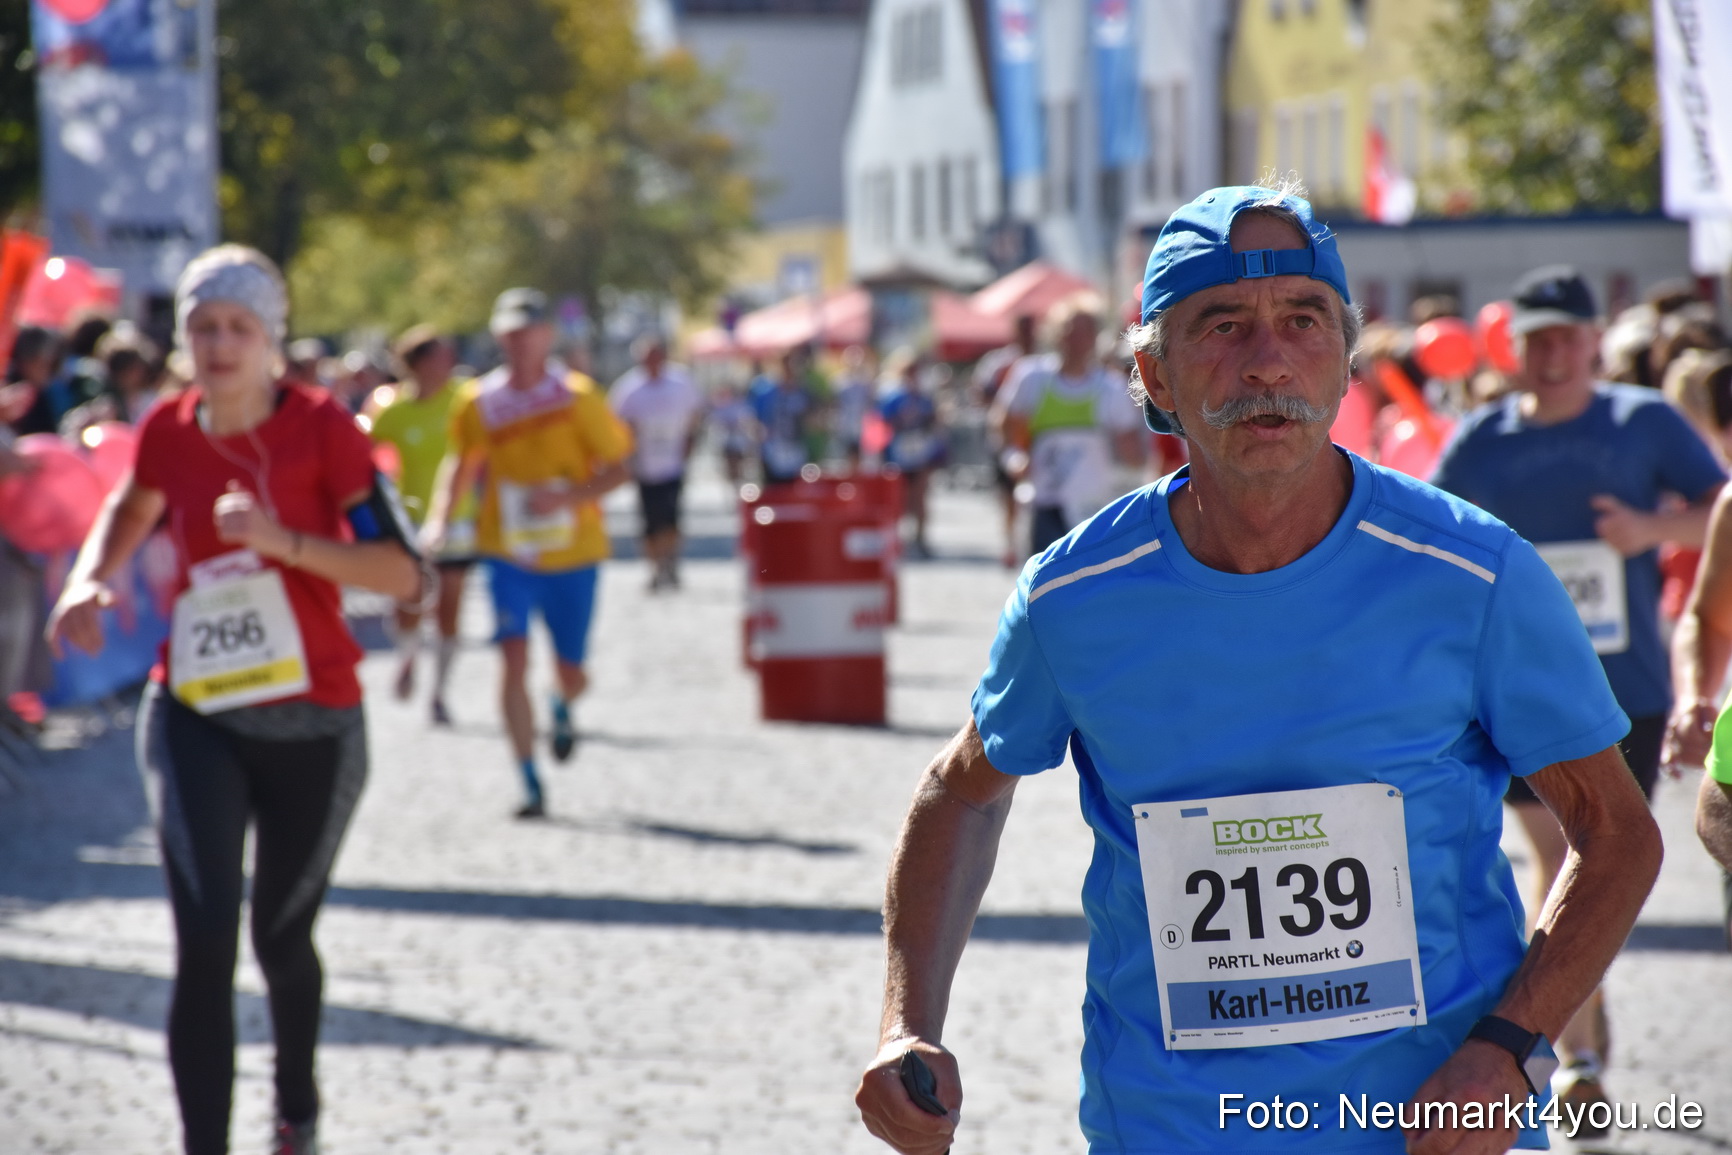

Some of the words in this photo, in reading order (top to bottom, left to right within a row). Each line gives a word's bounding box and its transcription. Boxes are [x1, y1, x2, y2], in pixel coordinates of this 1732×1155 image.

[191, 610, 266, 657] 266
[1213, 813, 1327, 846] BOCK
[1215, 846, 1248, 856] inspired
[1250, 845, 1261, 855] by
[1262, 843, 1288, 853] smart
[1289, 840, 1329, 850] concepts
[1185, 857, 1371, 943] 2139
[1167, 930, 1176, 943] D
[1208, 954, 1260, 969] PARTL
[1263, 947, 1340, 967] Neumarkt
[1208, 980, 1371, 1020] Karl-Heinz
